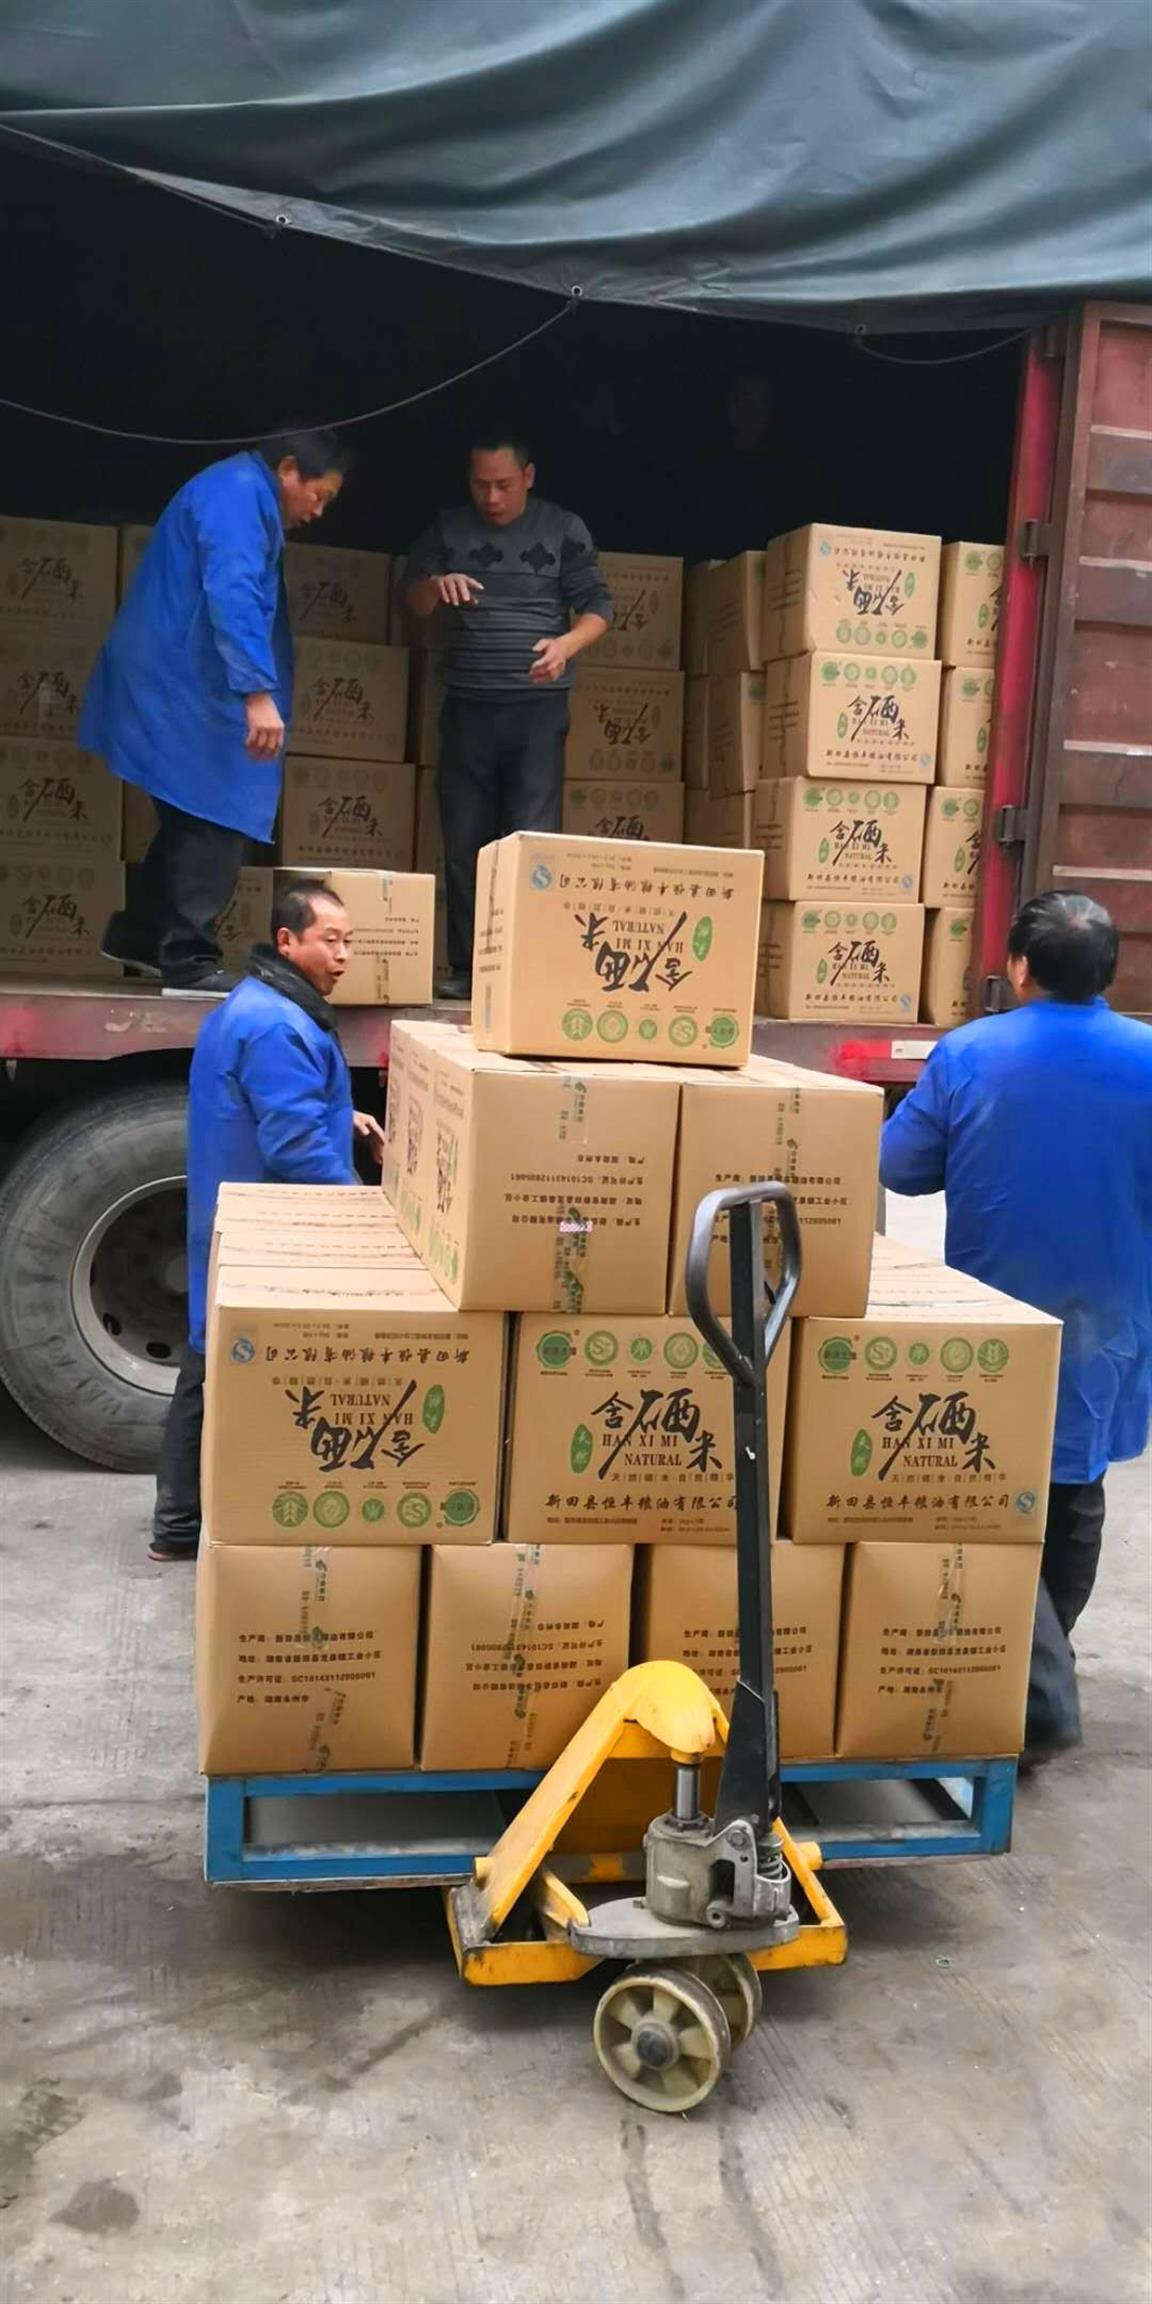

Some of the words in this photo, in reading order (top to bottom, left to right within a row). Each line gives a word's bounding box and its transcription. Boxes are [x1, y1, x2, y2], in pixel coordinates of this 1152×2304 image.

[842, 568, 905, 616] 含硒米
[847, 694, 910, 742] 含硒米
[829, 819, 893, 866] 含硒米
[559, 873, 735, 900] 新田县恒丰粮油有限公司
[612, 920, 665, 934] NATURAL
[574, 911, 693, 992] 含硒米
[615, 937, 631, 950] MI
[637, 939, 655, 952] XI
[827, 940, 890, 986] 含硒米
[266, 1346, 470, 1365] 新田县恒丰粮油有限公司
[329, 1393, 392, 1406] NATURAL
[285, 1379, 425, 1473] 含硒米
[333, 1412, 353, 1426] MI
[359, 1412, 376, 1426] XI
[591, 1387, 723, 1480] 含硒米
[639, 1434, 655, 1447] XI
[660, 1434, 678, 1447] MI
[872, 1391, 995, 1482] 含硒米
[917, 1437, 932, 1450] XI
[938, 1437, 954, 1450] MI
[624, 1453, 682, 1467] NATURAL
[903, 1454, 958, 1468] NATURAL
[545, 1494, 738, 1511] 新田县恒丰粮油有限公司
[826, 1494, 1010, 1510] 新田县恒丰粮油有限公司
